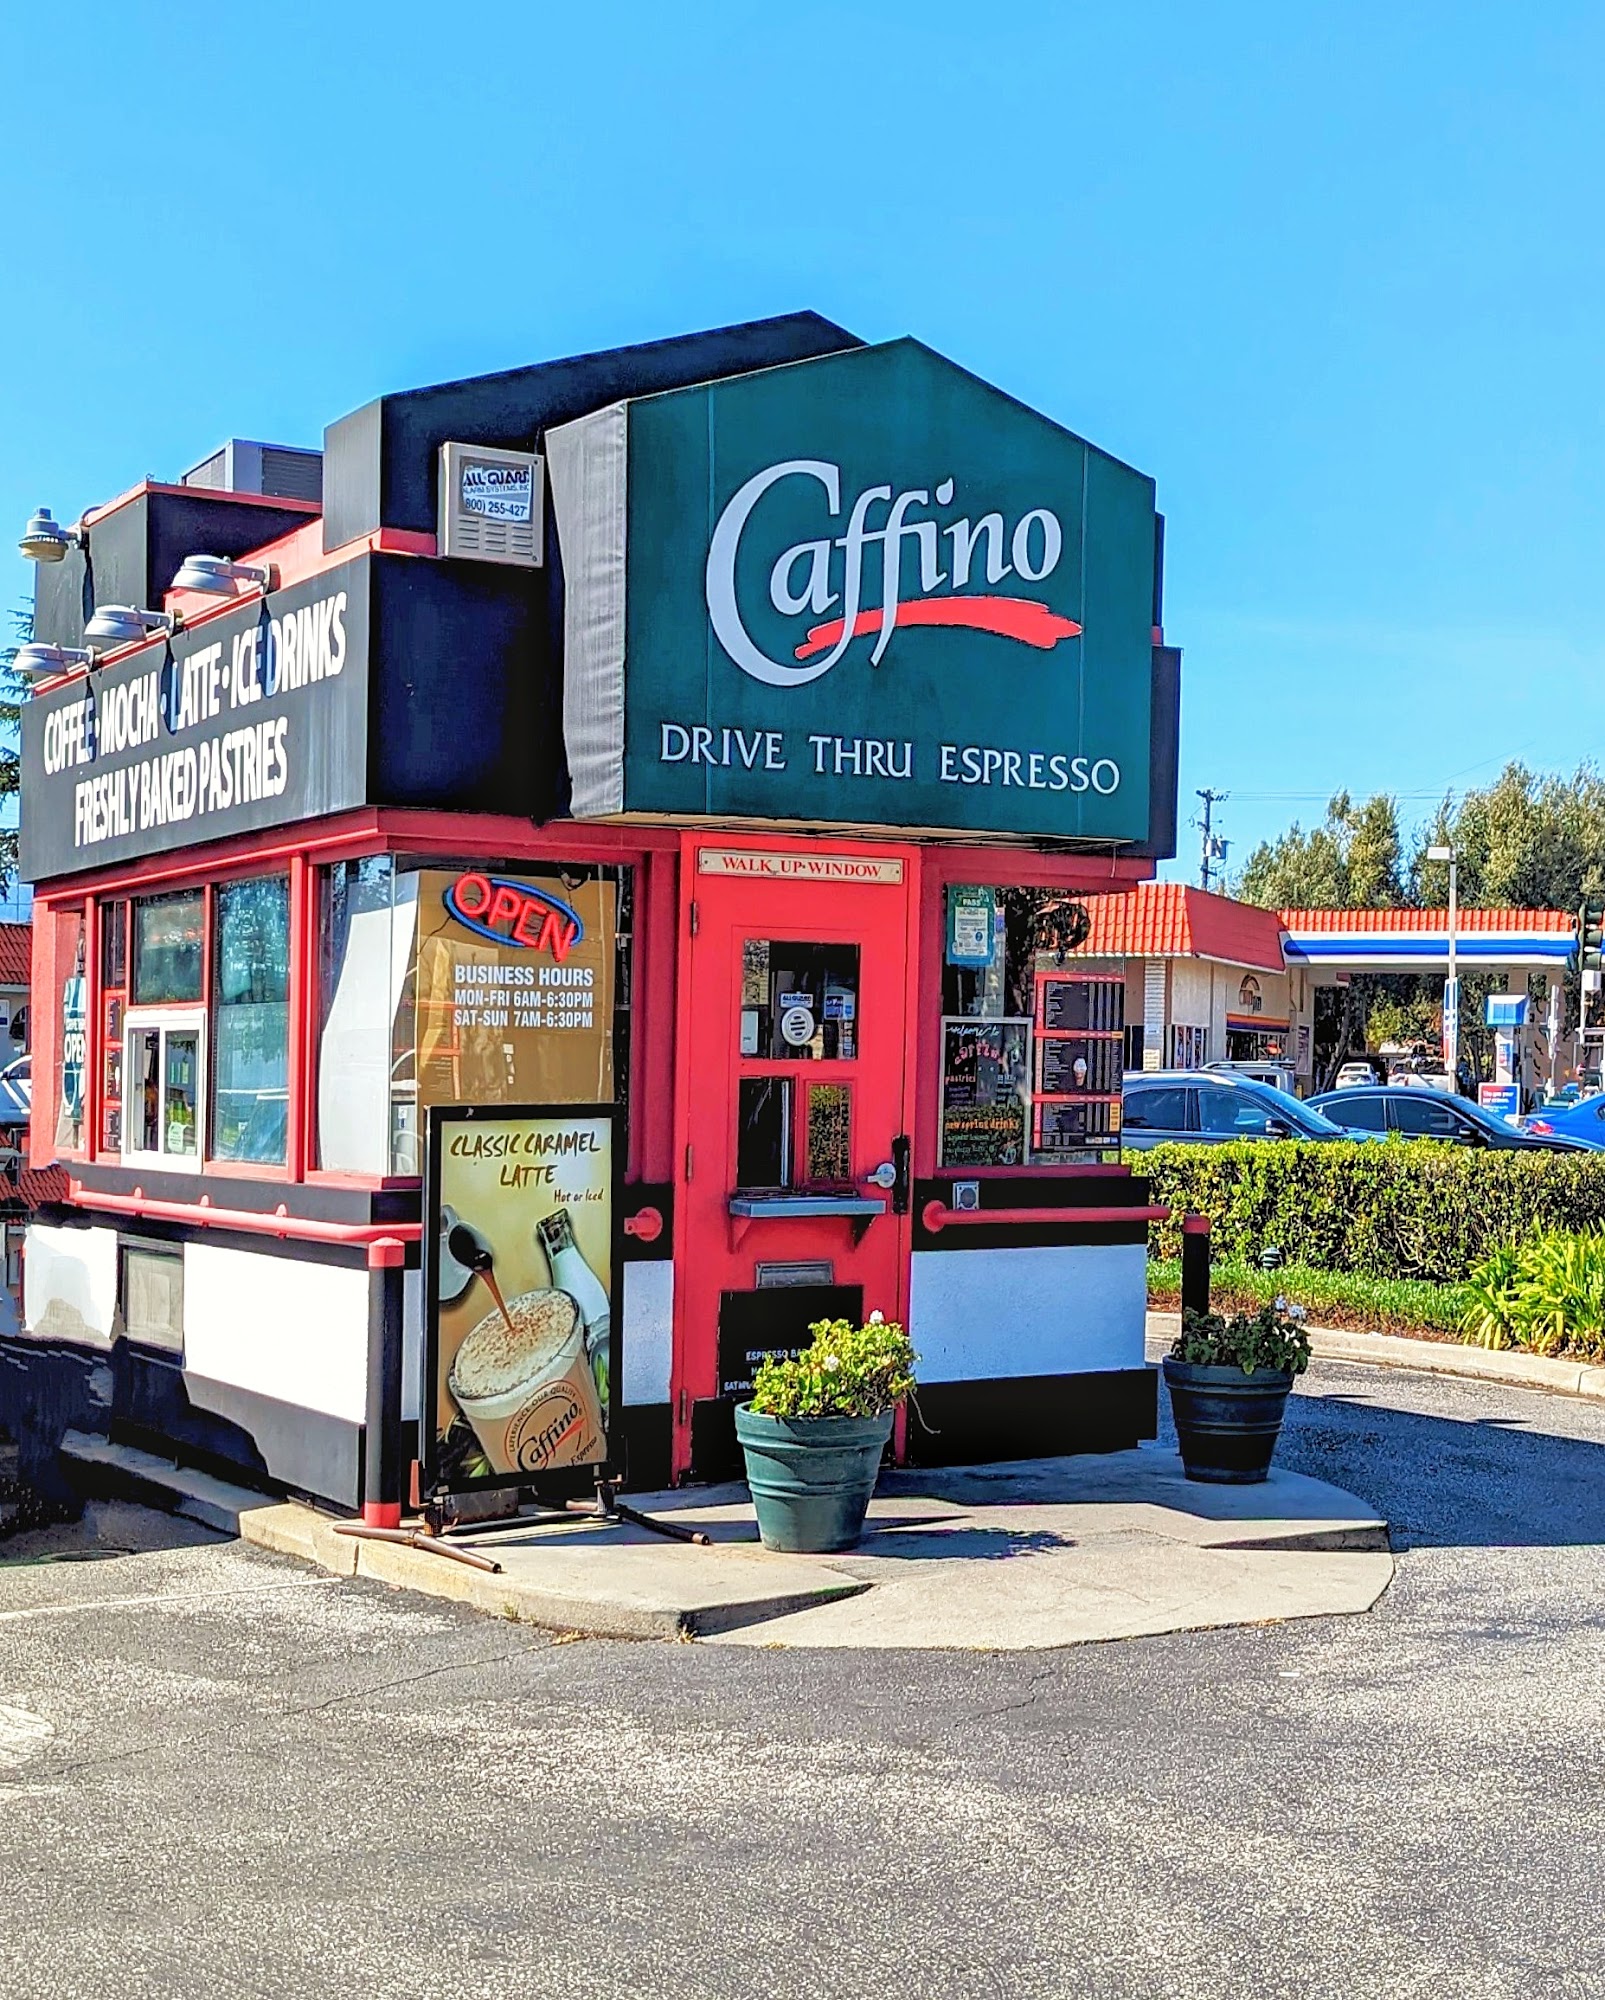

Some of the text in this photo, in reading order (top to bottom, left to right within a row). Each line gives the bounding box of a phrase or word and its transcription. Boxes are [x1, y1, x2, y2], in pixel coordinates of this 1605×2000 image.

[463, 472, 486, 487] ALL
[706, 459, 1061, 686] Caffino
[43, 591, 347, 776] COFFEE MOCHA LATTE ICE DRINKS
[660, 722, 1120, 794] DRIVE THRU ESPRESSO
[74, 716, 289, 847] FRESHLY BAKED PASTRIES
[722, 856, 882, 877] WALK UP WINDOW
[452, 871, 577, 962] OPEN
[454, 964, 594, 987] BUSINESS HOURS
[454, 988, 593, 1008] MON-FRI 6AM-6:30PM
[454, 1009, 593, 1028] SAT-SUN 7AM-6:30PM
[450, 1130, 601, 1159] CLASSIC CARAMEL
[500, 1164, 559, 1189] LATTE
[554, 1188, 604, 1203] Hot or Iced
[531, 1389, 548, 1406] OUR
[517, 1402, 579, 1472] Caffino
